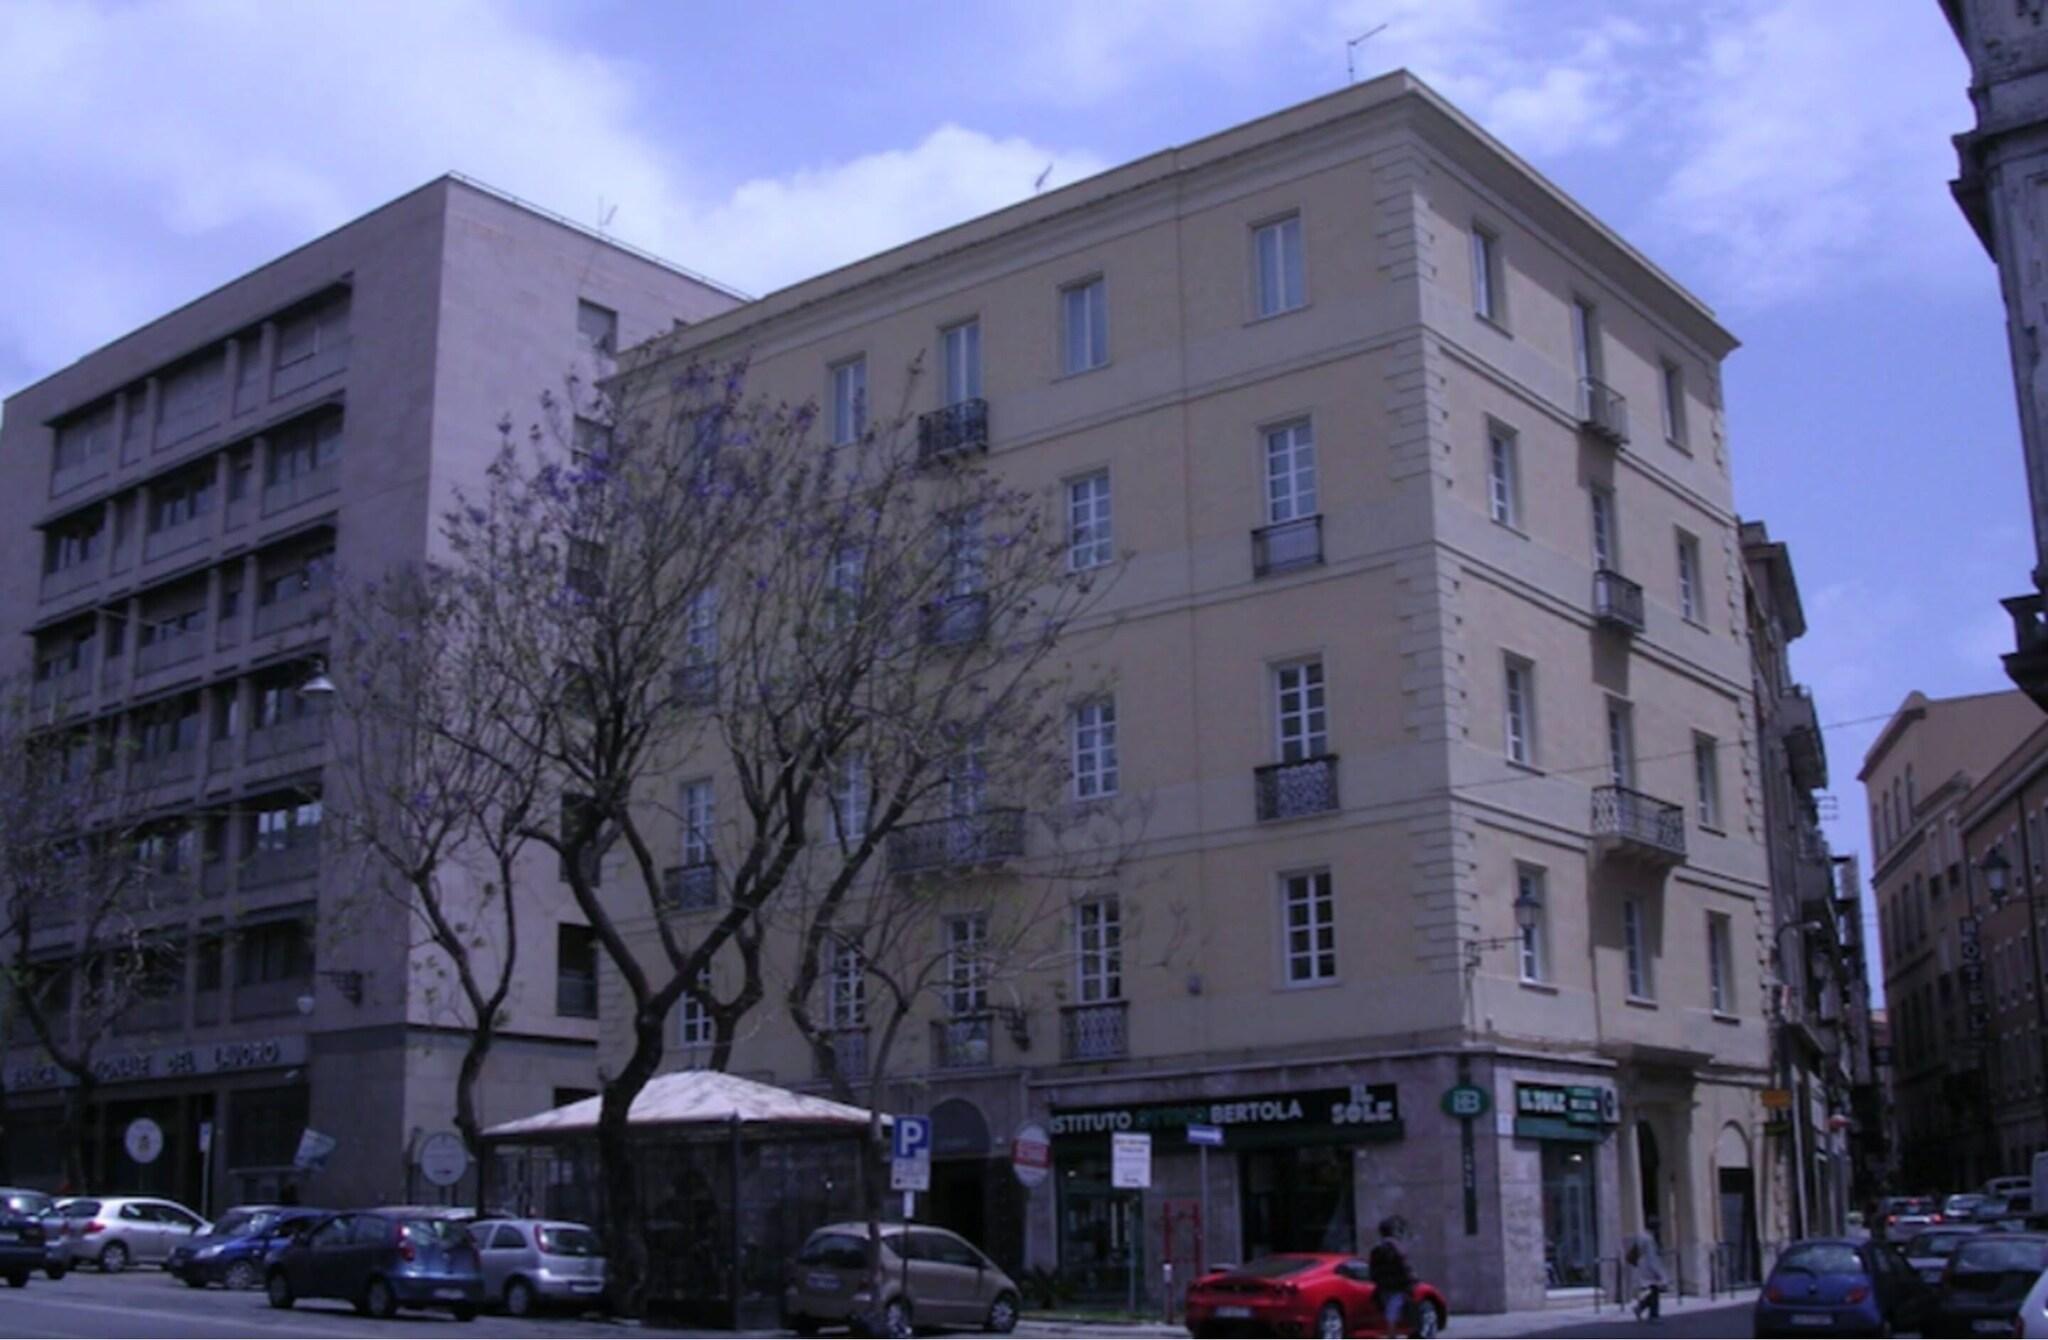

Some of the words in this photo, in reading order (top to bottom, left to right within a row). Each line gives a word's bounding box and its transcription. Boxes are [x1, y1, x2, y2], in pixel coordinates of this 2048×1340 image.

[1349, 1084, 1374, 1103] IL
[1209, 1099, 1304, 1124] BERTOLA
[1331, 1101, 1393, 1125] SOLE
[900, 1119, 924, 1156] P
